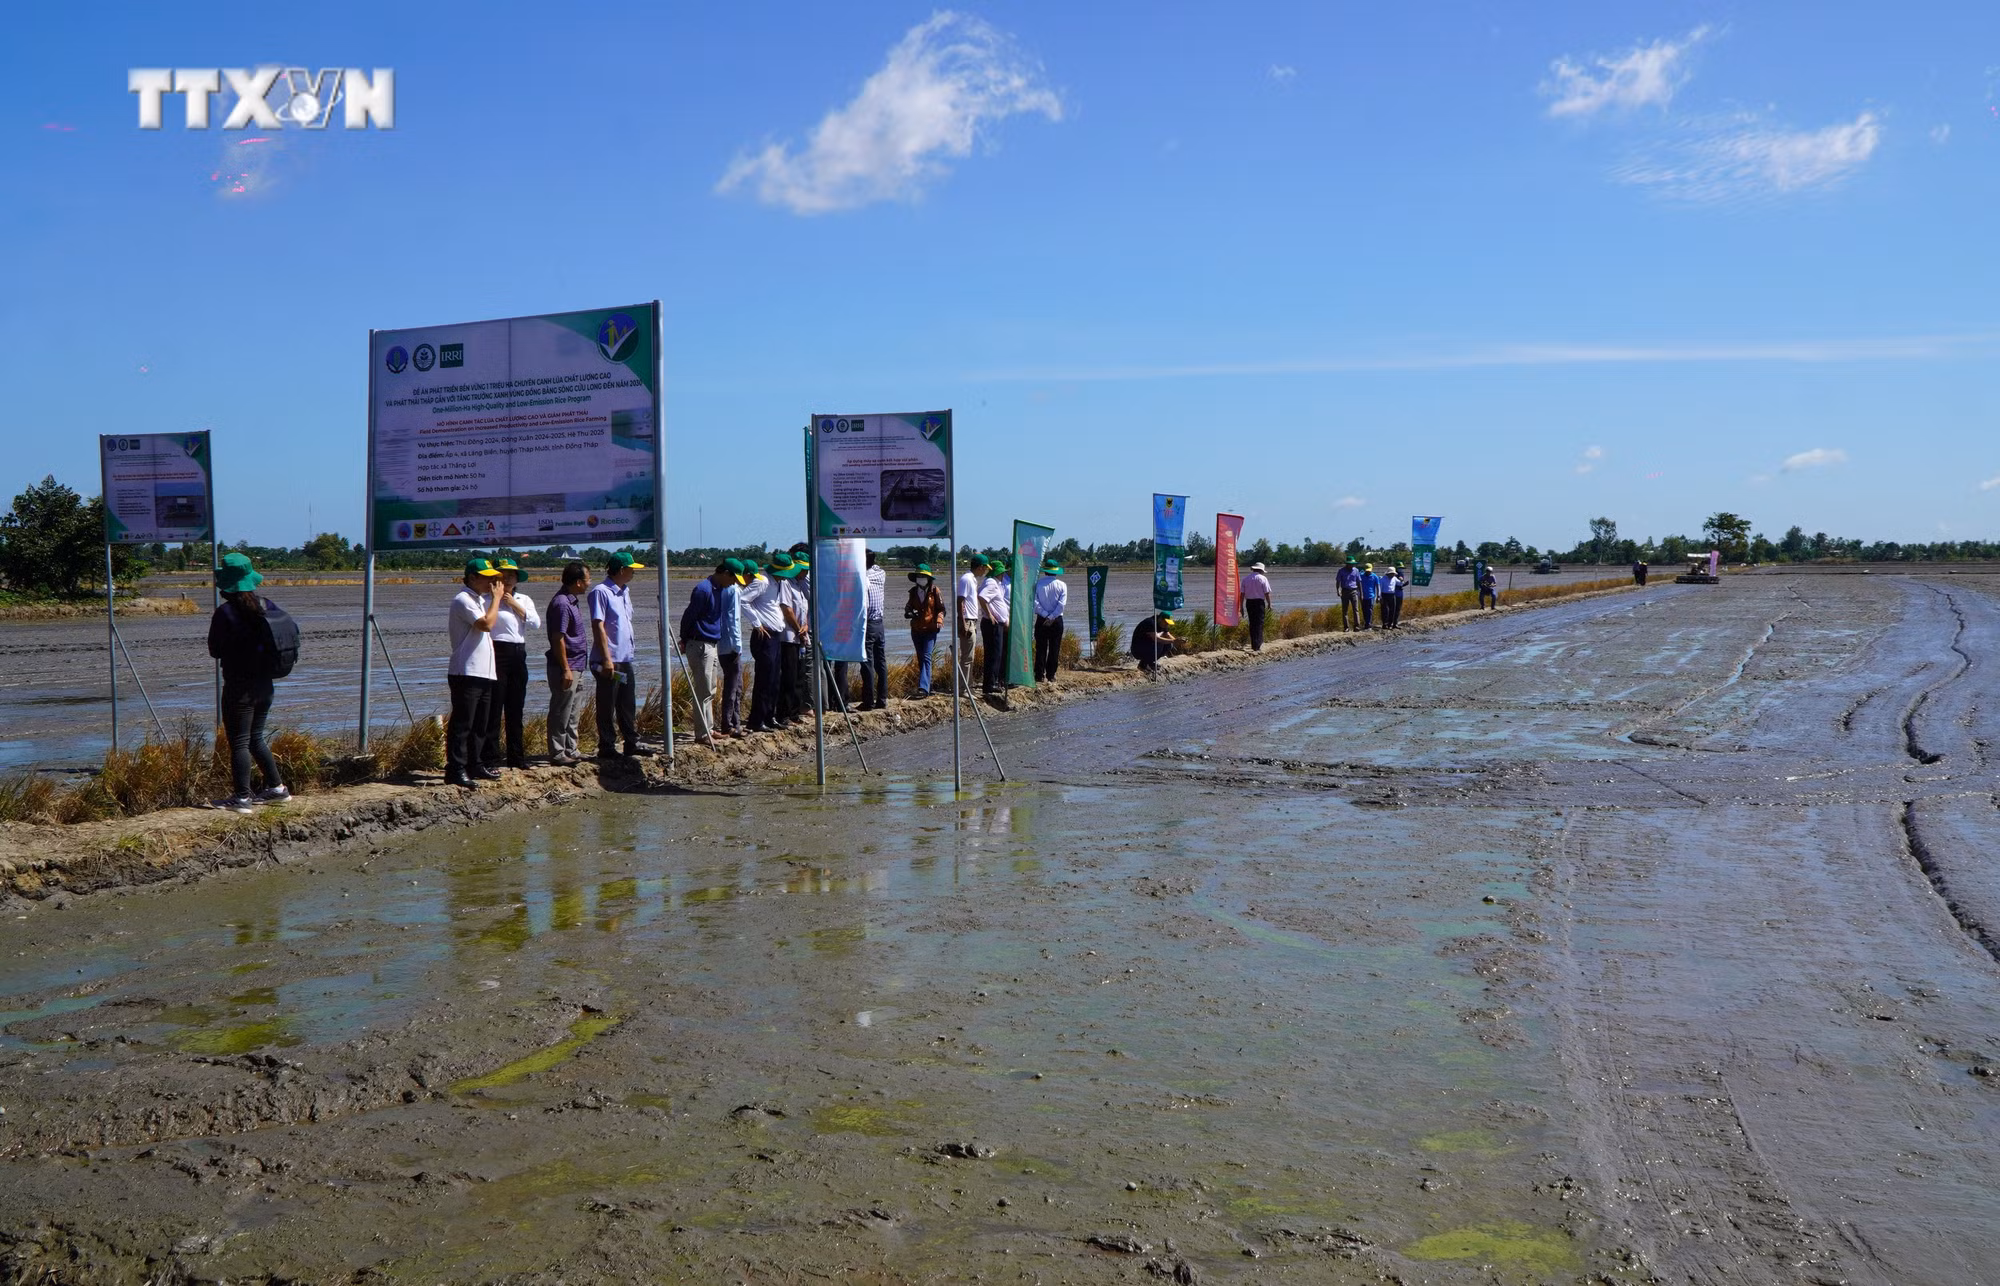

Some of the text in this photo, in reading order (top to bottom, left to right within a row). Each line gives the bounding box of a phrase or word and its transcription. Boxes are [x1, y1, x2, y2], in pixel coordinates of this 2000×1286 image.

[442, 350, 462, 362] IRRI
[495, 391, 508, 399] XANH
[587, 383, 602, 391] LONG
[472, 402, 504, 413] High-Quality
[517, 397, 553, 407] Low-Emission
[555, 396, 566, 404] Rice
[568, 395, 591, 404] Program
[499, 422, 528, 430] Productivity
[586, 416, 607, 424] Farming
